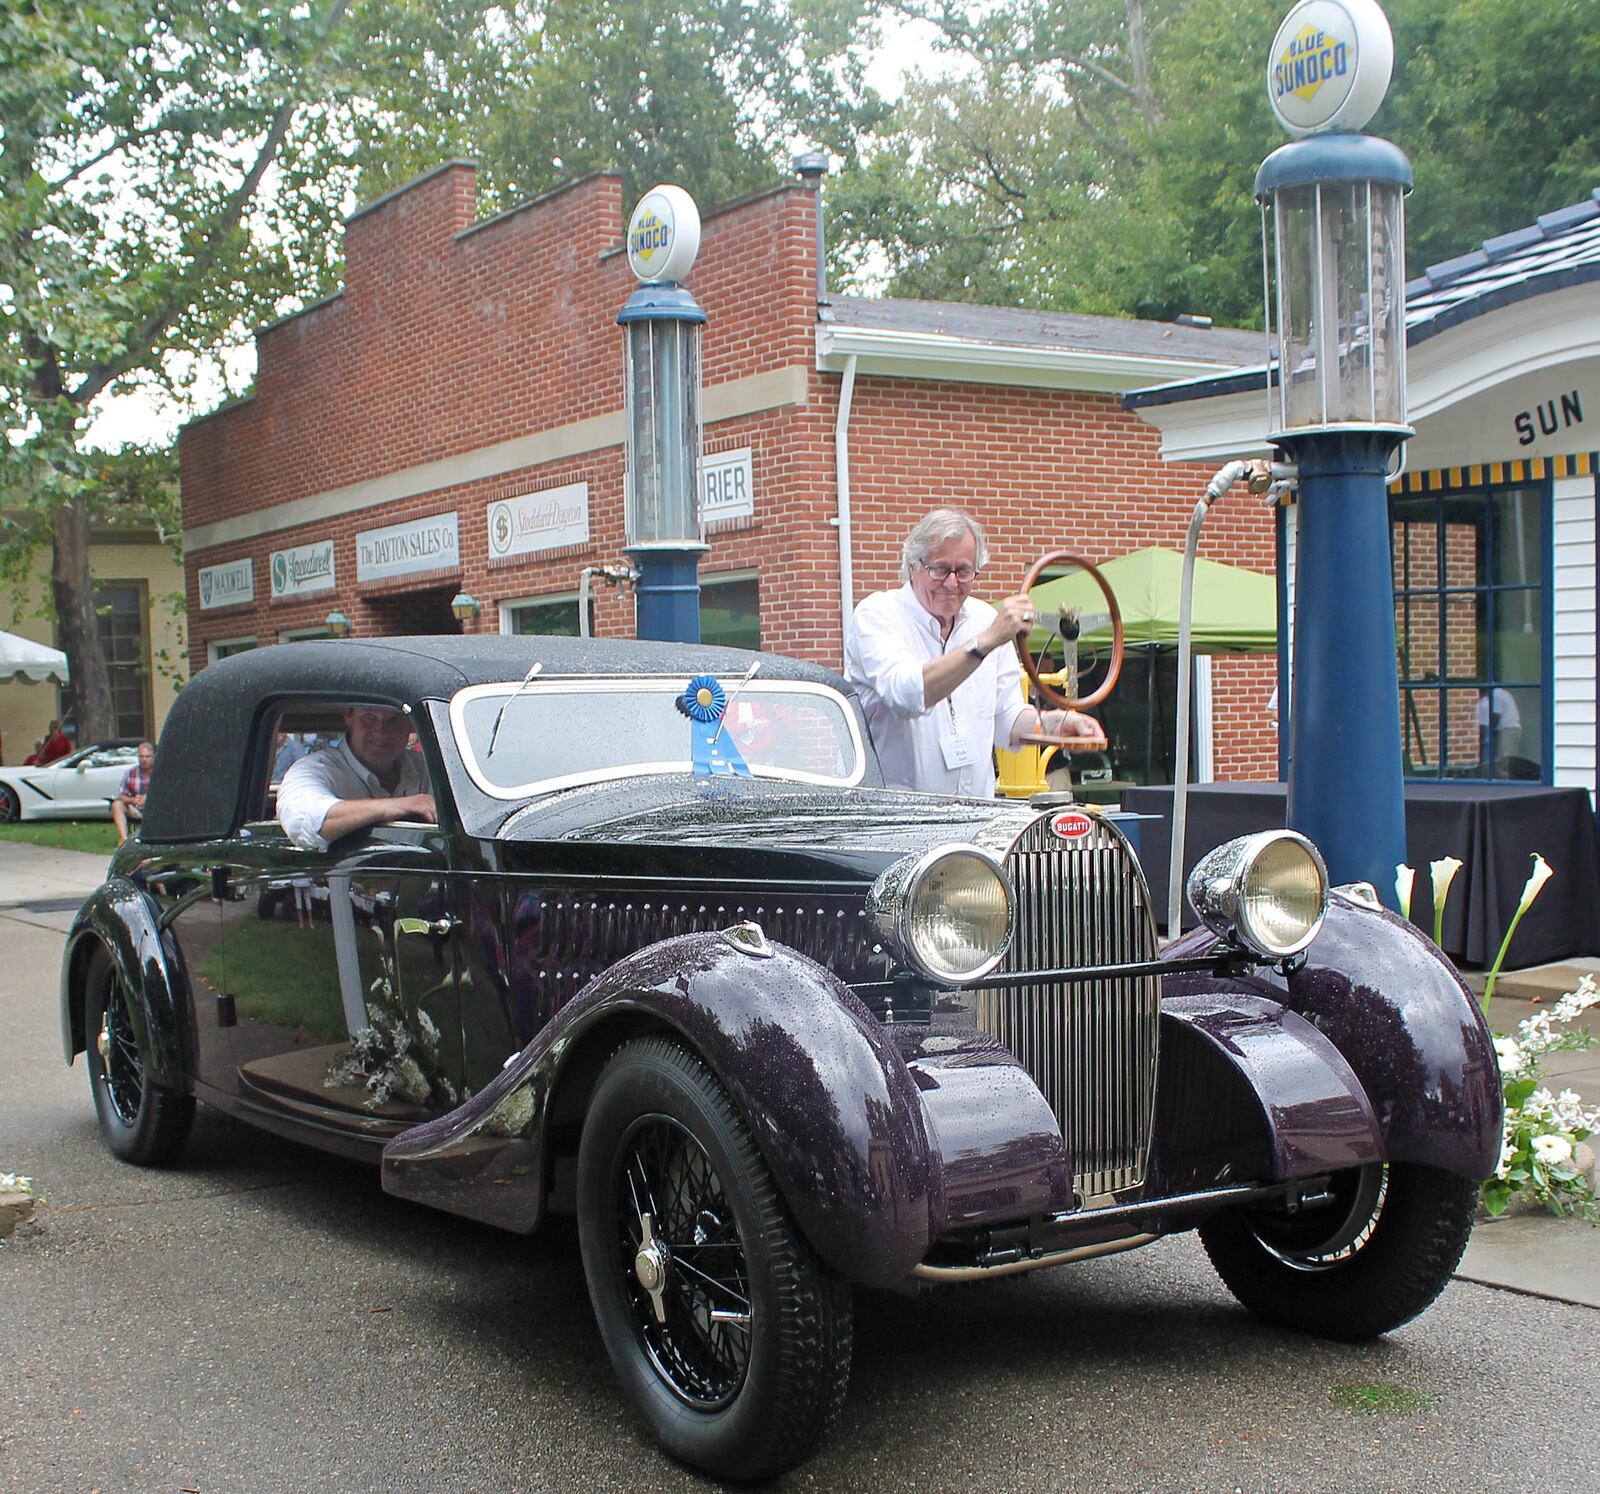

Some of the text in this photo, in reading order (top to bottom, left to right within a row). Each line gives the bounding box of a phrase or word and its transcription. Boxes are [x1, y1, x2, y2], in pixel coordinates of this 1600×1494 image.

[1289, 32, 1325, 57] BLUE
[1276, 42, 1347, 97] SUNOCO
[638, 215, 657, 230] BLUE
[631, 224, 668, 254] SUNOCO
[1514, 390, 1584, 446] SUN
[360, 546, 373, 565] The
[374, 535, 409, 564] DAYTON
[409, 528, 440, 557] SALES
[213, 567, 251, 596] MAXWELL
[288, 546, 332, 587] Speedwell
[1057, 822, 1088, 832] BUGATTI
